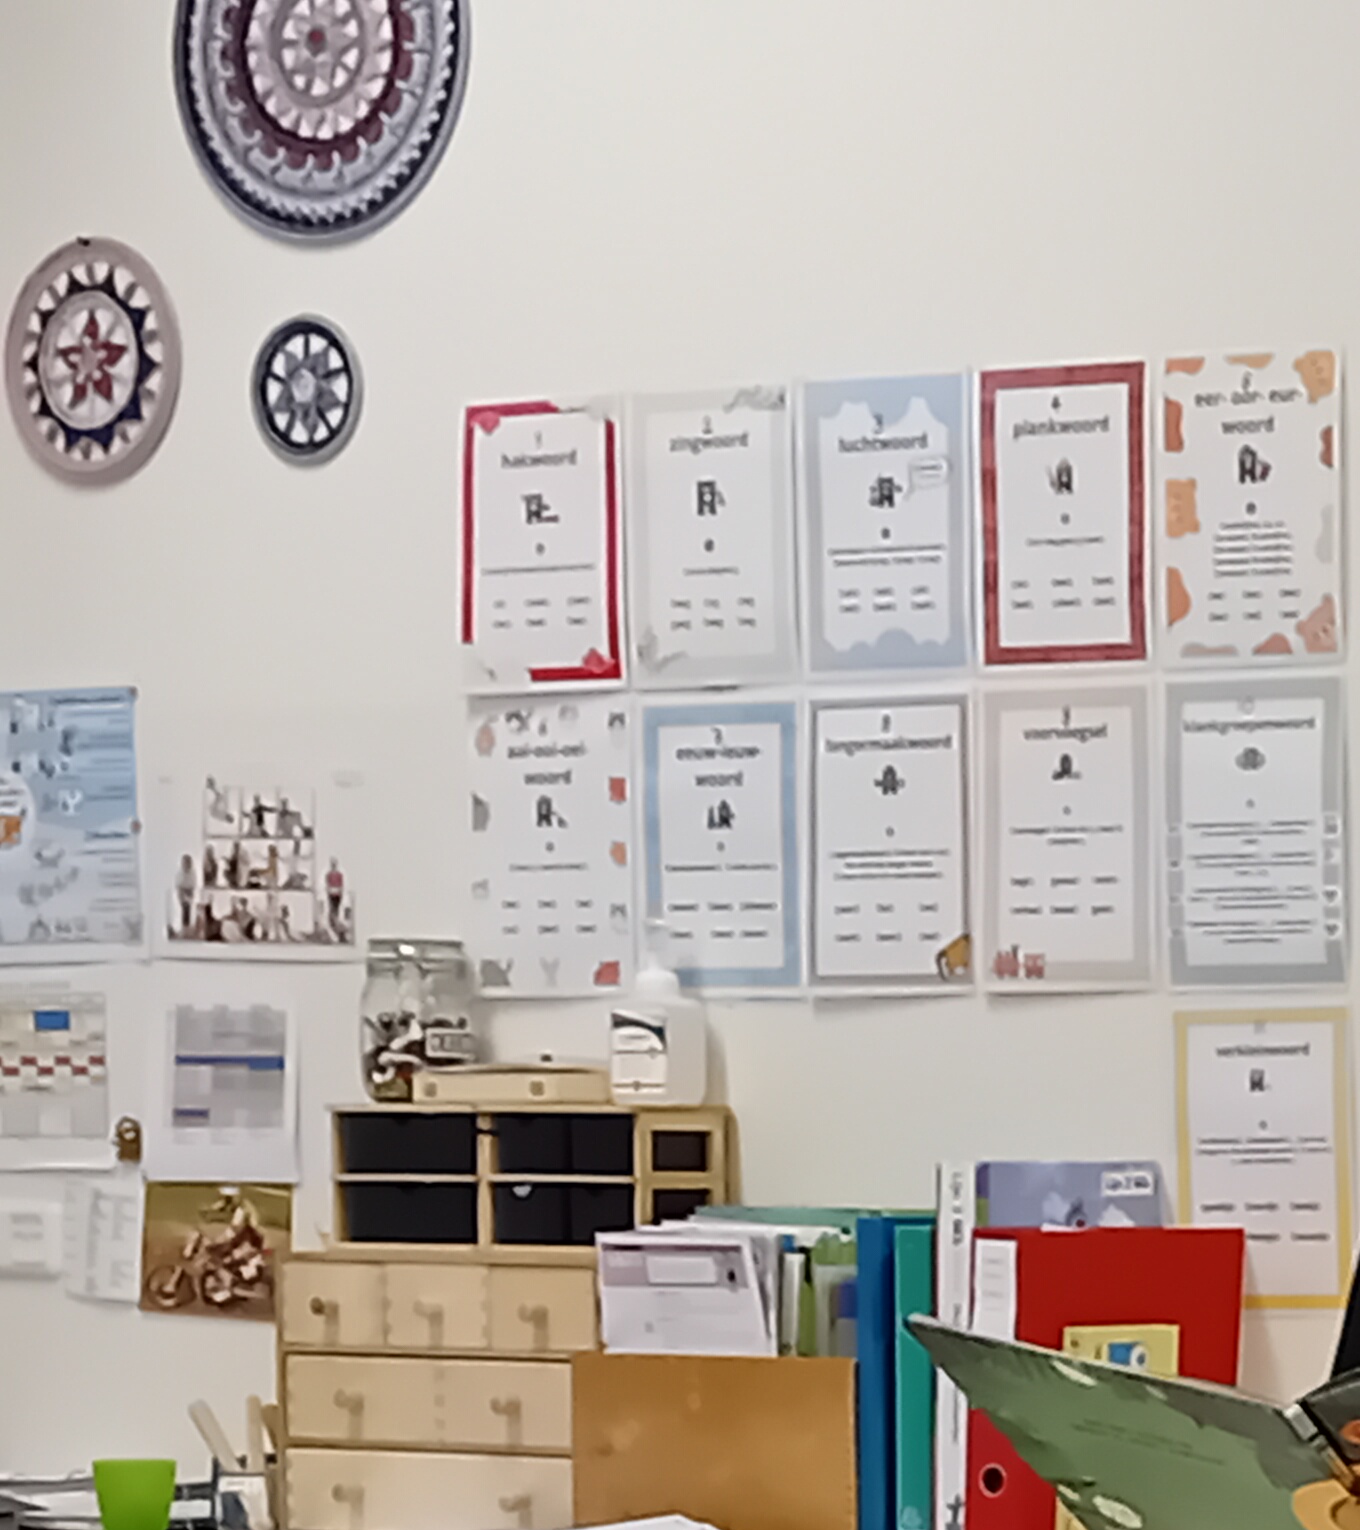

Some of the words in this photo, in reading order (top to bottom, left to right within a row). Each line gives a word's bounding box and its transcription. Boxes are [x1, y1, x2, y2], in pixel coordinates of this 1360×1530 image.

[1012, 414, 1110, 441] plankwoord
[1221, 414, 1275, 435] woord
[668, 430, 749, 455] zingwoord
[837, 430, 928, 453] luchtwoord
[500, 448, 577, 469] hakwoord
